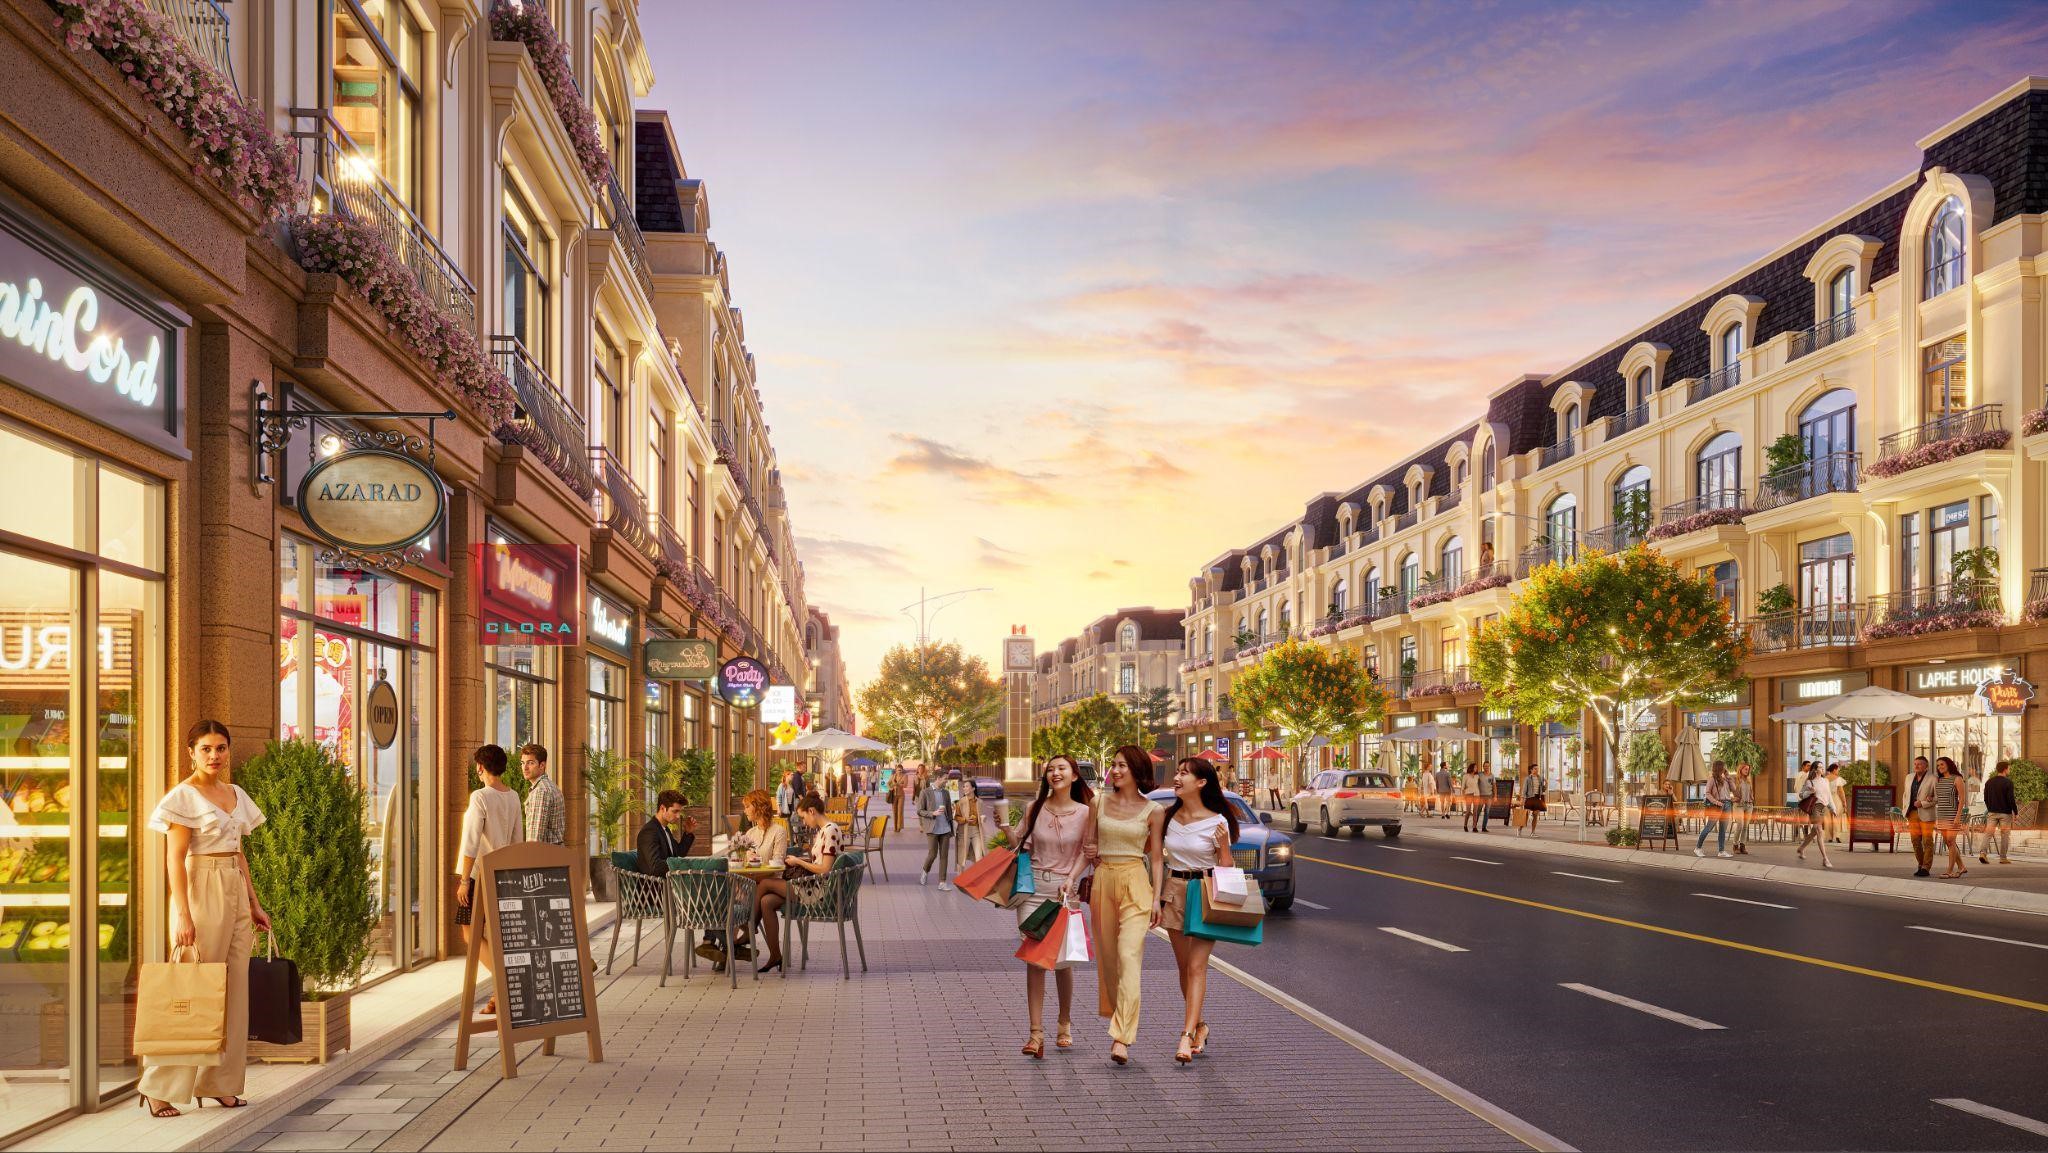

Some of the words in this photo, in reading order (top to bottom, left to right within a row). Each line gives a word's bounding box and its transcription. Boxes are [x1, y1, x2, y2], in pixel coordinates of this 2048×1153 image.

[319, 483, 421, 502] AZARAD
[486, 622, 572, 634] CLORA
[725, 665, 764, 690] Party
[1919, 670, 1958, 688] LAPHE
[374, 705, 395, 725] OPEN
[522, 872, 545, 889] MENU
